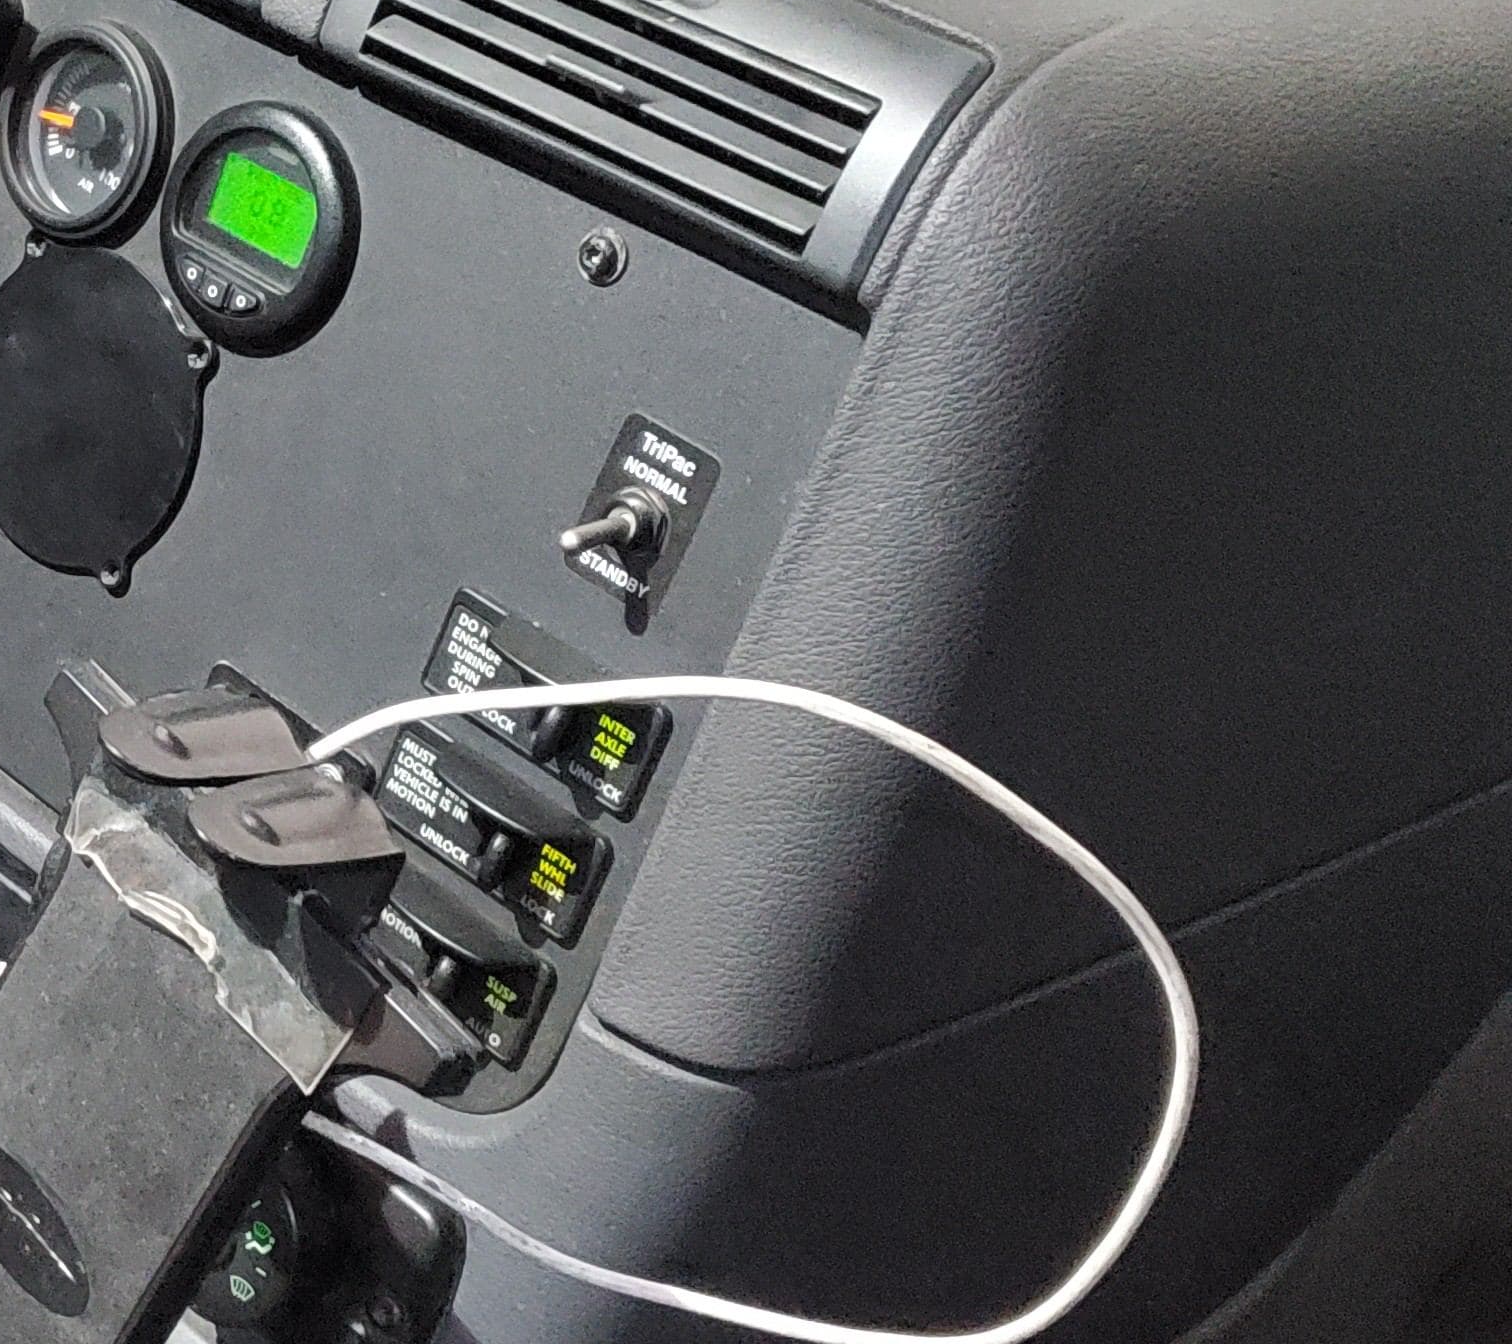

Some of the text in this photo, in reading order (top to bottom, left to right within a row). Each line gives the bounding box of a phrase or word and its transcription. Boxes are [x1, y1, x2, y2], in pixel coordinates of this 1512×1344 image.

[641, 431, 697, 478] TriPac
[623, 455, 688, 505] NORMAL
[579, 549, 650, 599] STANDBY
[458, 612, 479, 633] DO
[448, 640, 496, 679] DURING
[452, 625, 503, 667] ENGAGE
[451, 660, 481, 687] SPIN
[594, 731, 627, 758] AXLE
[598, 714, 636, 746] INTER
[402, 737, 437, 767] MUST
[590, 745, 621, 771] DIFF
[386, 777, 437, 819] MOTION
[393, 763, 439, 803] VEHICLE
[439, 796, 452, 813] IS
[452, 805, 469, 824] IN
[568, 760, 623, 804] UNLOCK
[419, 823, 470, 866] UNLOCK
[541, 843, 577, 875] FIFTH
[529, 871, 565, 903] SLIDE
[539, 858, 566, 887] WHL
[520, 894, 556, 926] LOCK
[483, 993, 507, 1016] AIR
[485, 975, 518, 1003] SUSP
